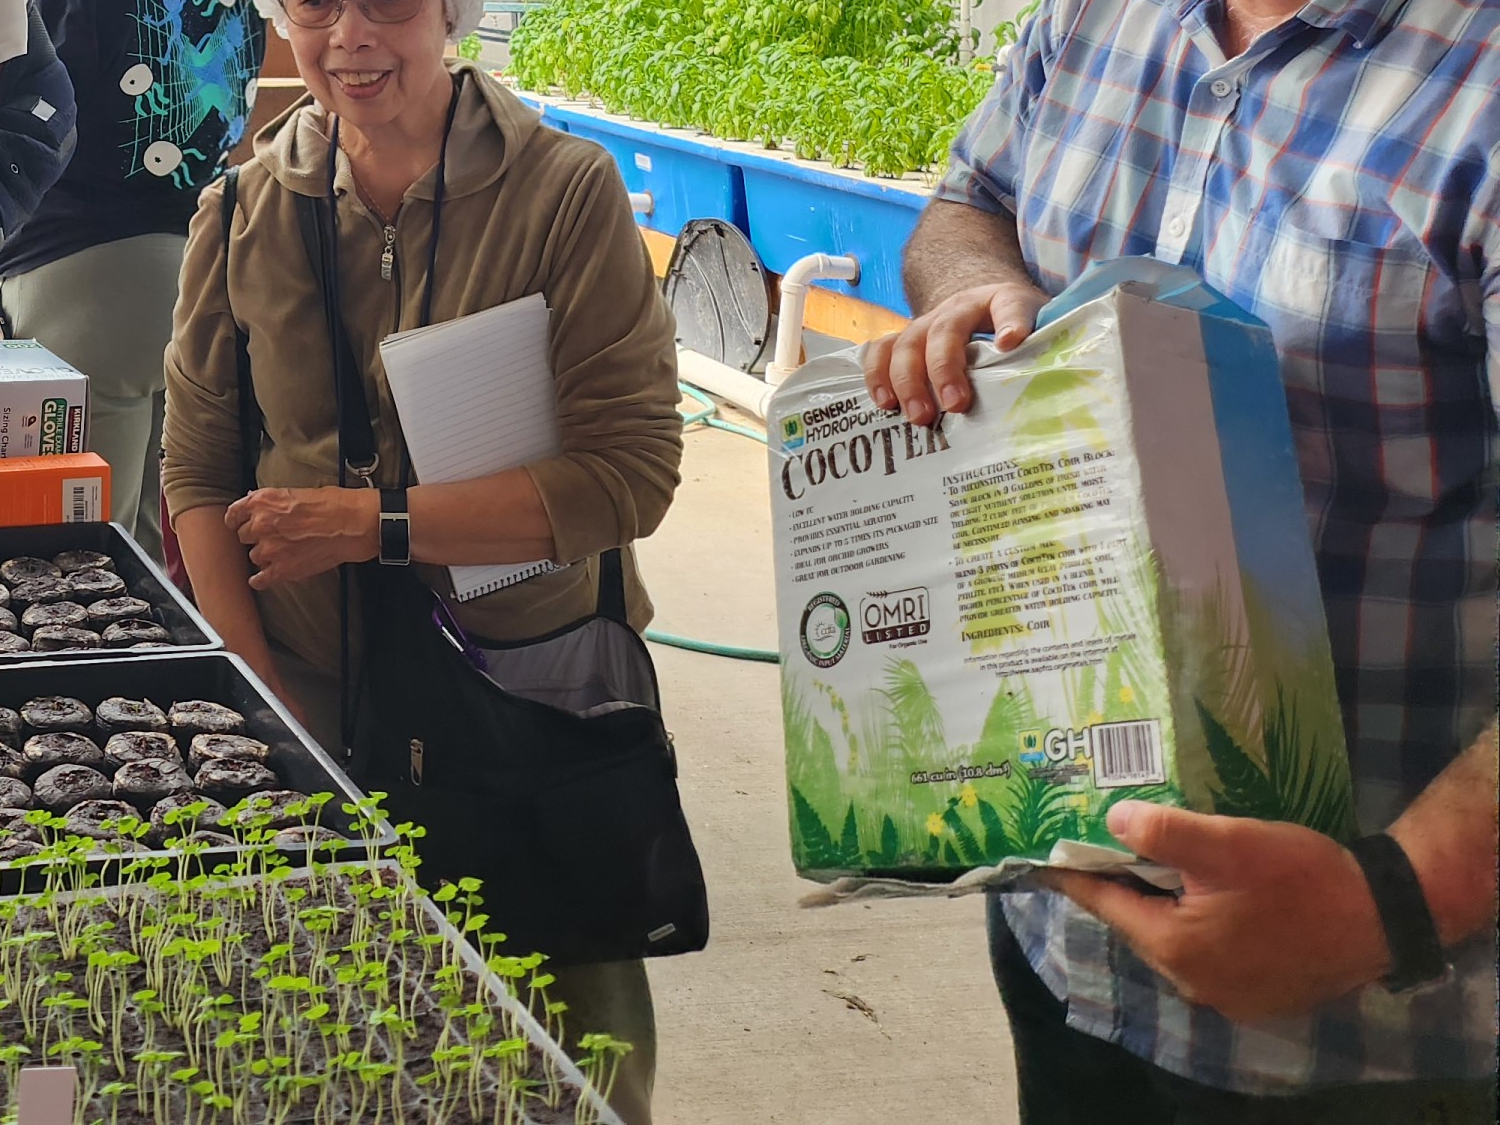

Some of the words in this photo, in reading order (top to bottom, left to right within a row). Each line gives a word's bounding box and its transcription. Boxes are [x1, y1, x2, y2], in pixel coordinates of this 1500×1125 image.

[1, 408, 11, 436] Sizing
[56, 405, 65, 434] NITRILE
[803, 397, 861, 425] GENERAL
[71, 408, 82, 452] KIRKLAND
[828, 511, 848, 522] WATER
[850, 503, 881, 517] HOLDING
[882, 494, 915, 508] CAPACITY
[1096, 498, 1111, 507] MAY
[793, 531, 825, 545] PROVIDES
[826, 522, 861, 537] ESSENTIAL
[863, 513, 897, 527] AERATION
[794, 545, 821, 557] EXPANDS
[851, 532, 872, 544] TIMES
[873, 529, 884, 538] ITS
[886, 521, 921, 535] PACKAGED
[923, 516, 939, 526] SIZE
[795, 572, 815, 583] GREAT
[830, 561, 864, 575] OUTDOOR
[865, 551, 906, 567] GARDENING
[814, 557, 827, 567] FOR
[828, 549, 855, 563] ORCHID
[856, 542, 890, 557] GROWERS
[865, 595, 926, 628] OMRI
[865, 624, 927, 643] LISTED
[1044, 727, 1092, 761] GH
[911, 771, 928, 783] 661
[930, 773, 943, 781] cu
[945, 768, 957, 780] in
